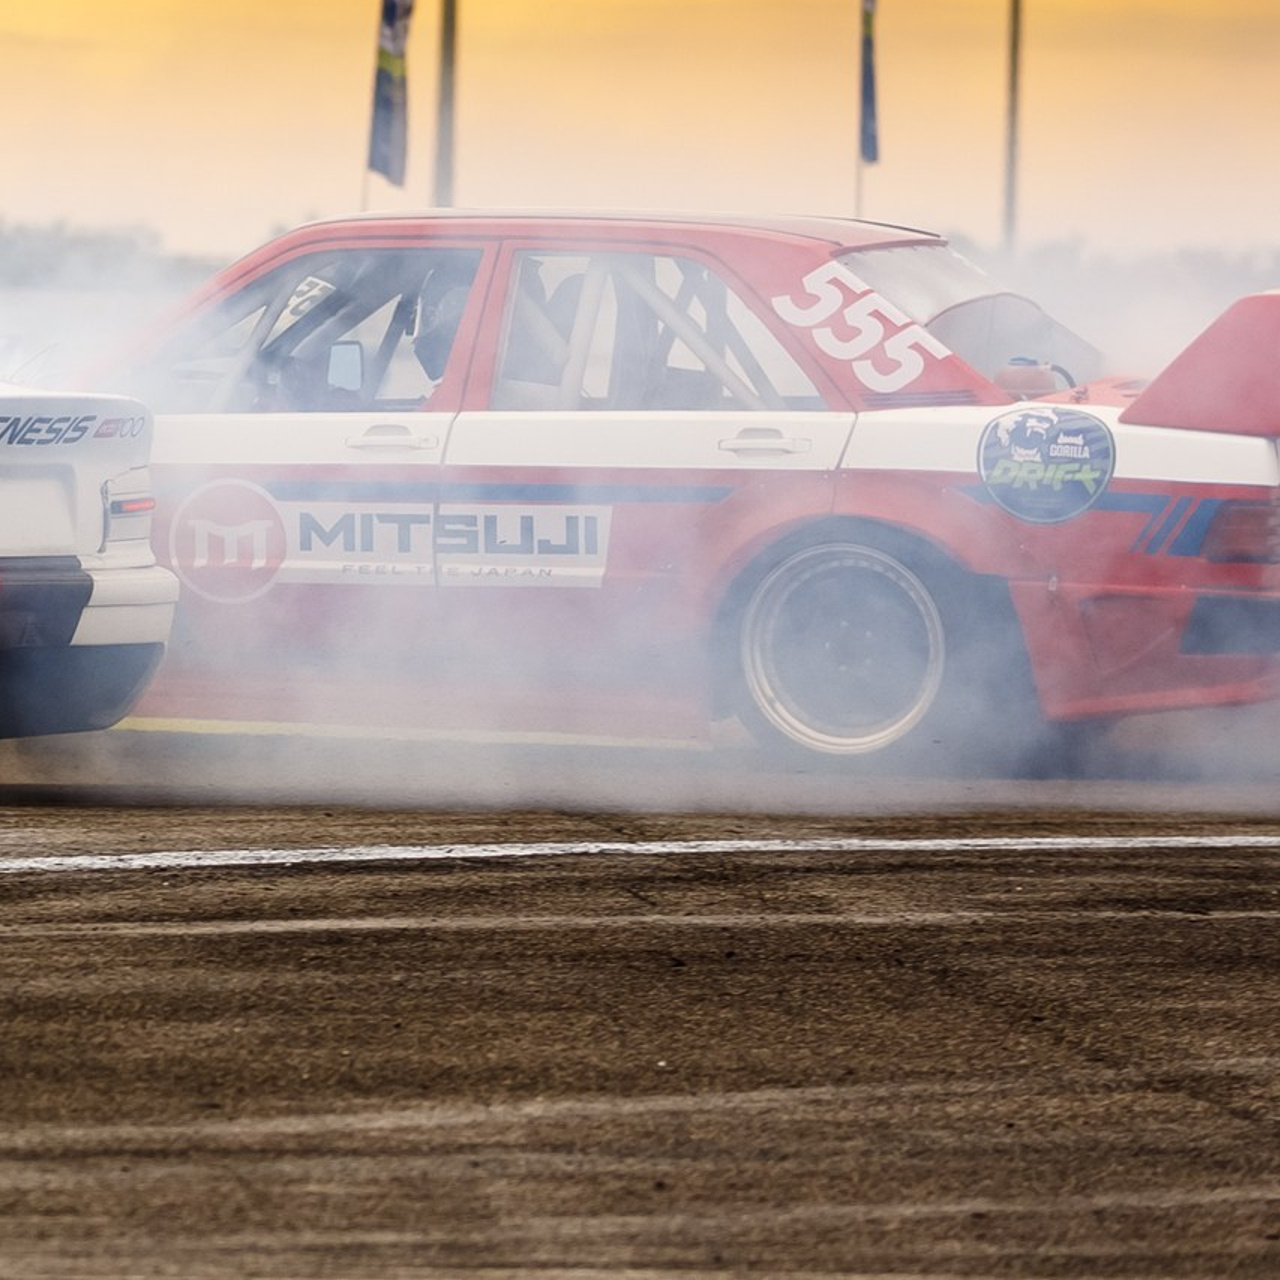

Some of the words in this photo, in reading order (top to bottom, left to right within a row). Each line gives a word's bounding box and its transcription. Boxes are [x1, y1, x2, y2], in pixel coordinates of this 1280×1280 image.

[771, 260, 954, 393] 555
[1049, 444, 1090, 459] GORILLA
[299, 512, 599, 556] MITSUJI
[471, 567, 554, 578] JAPAN
